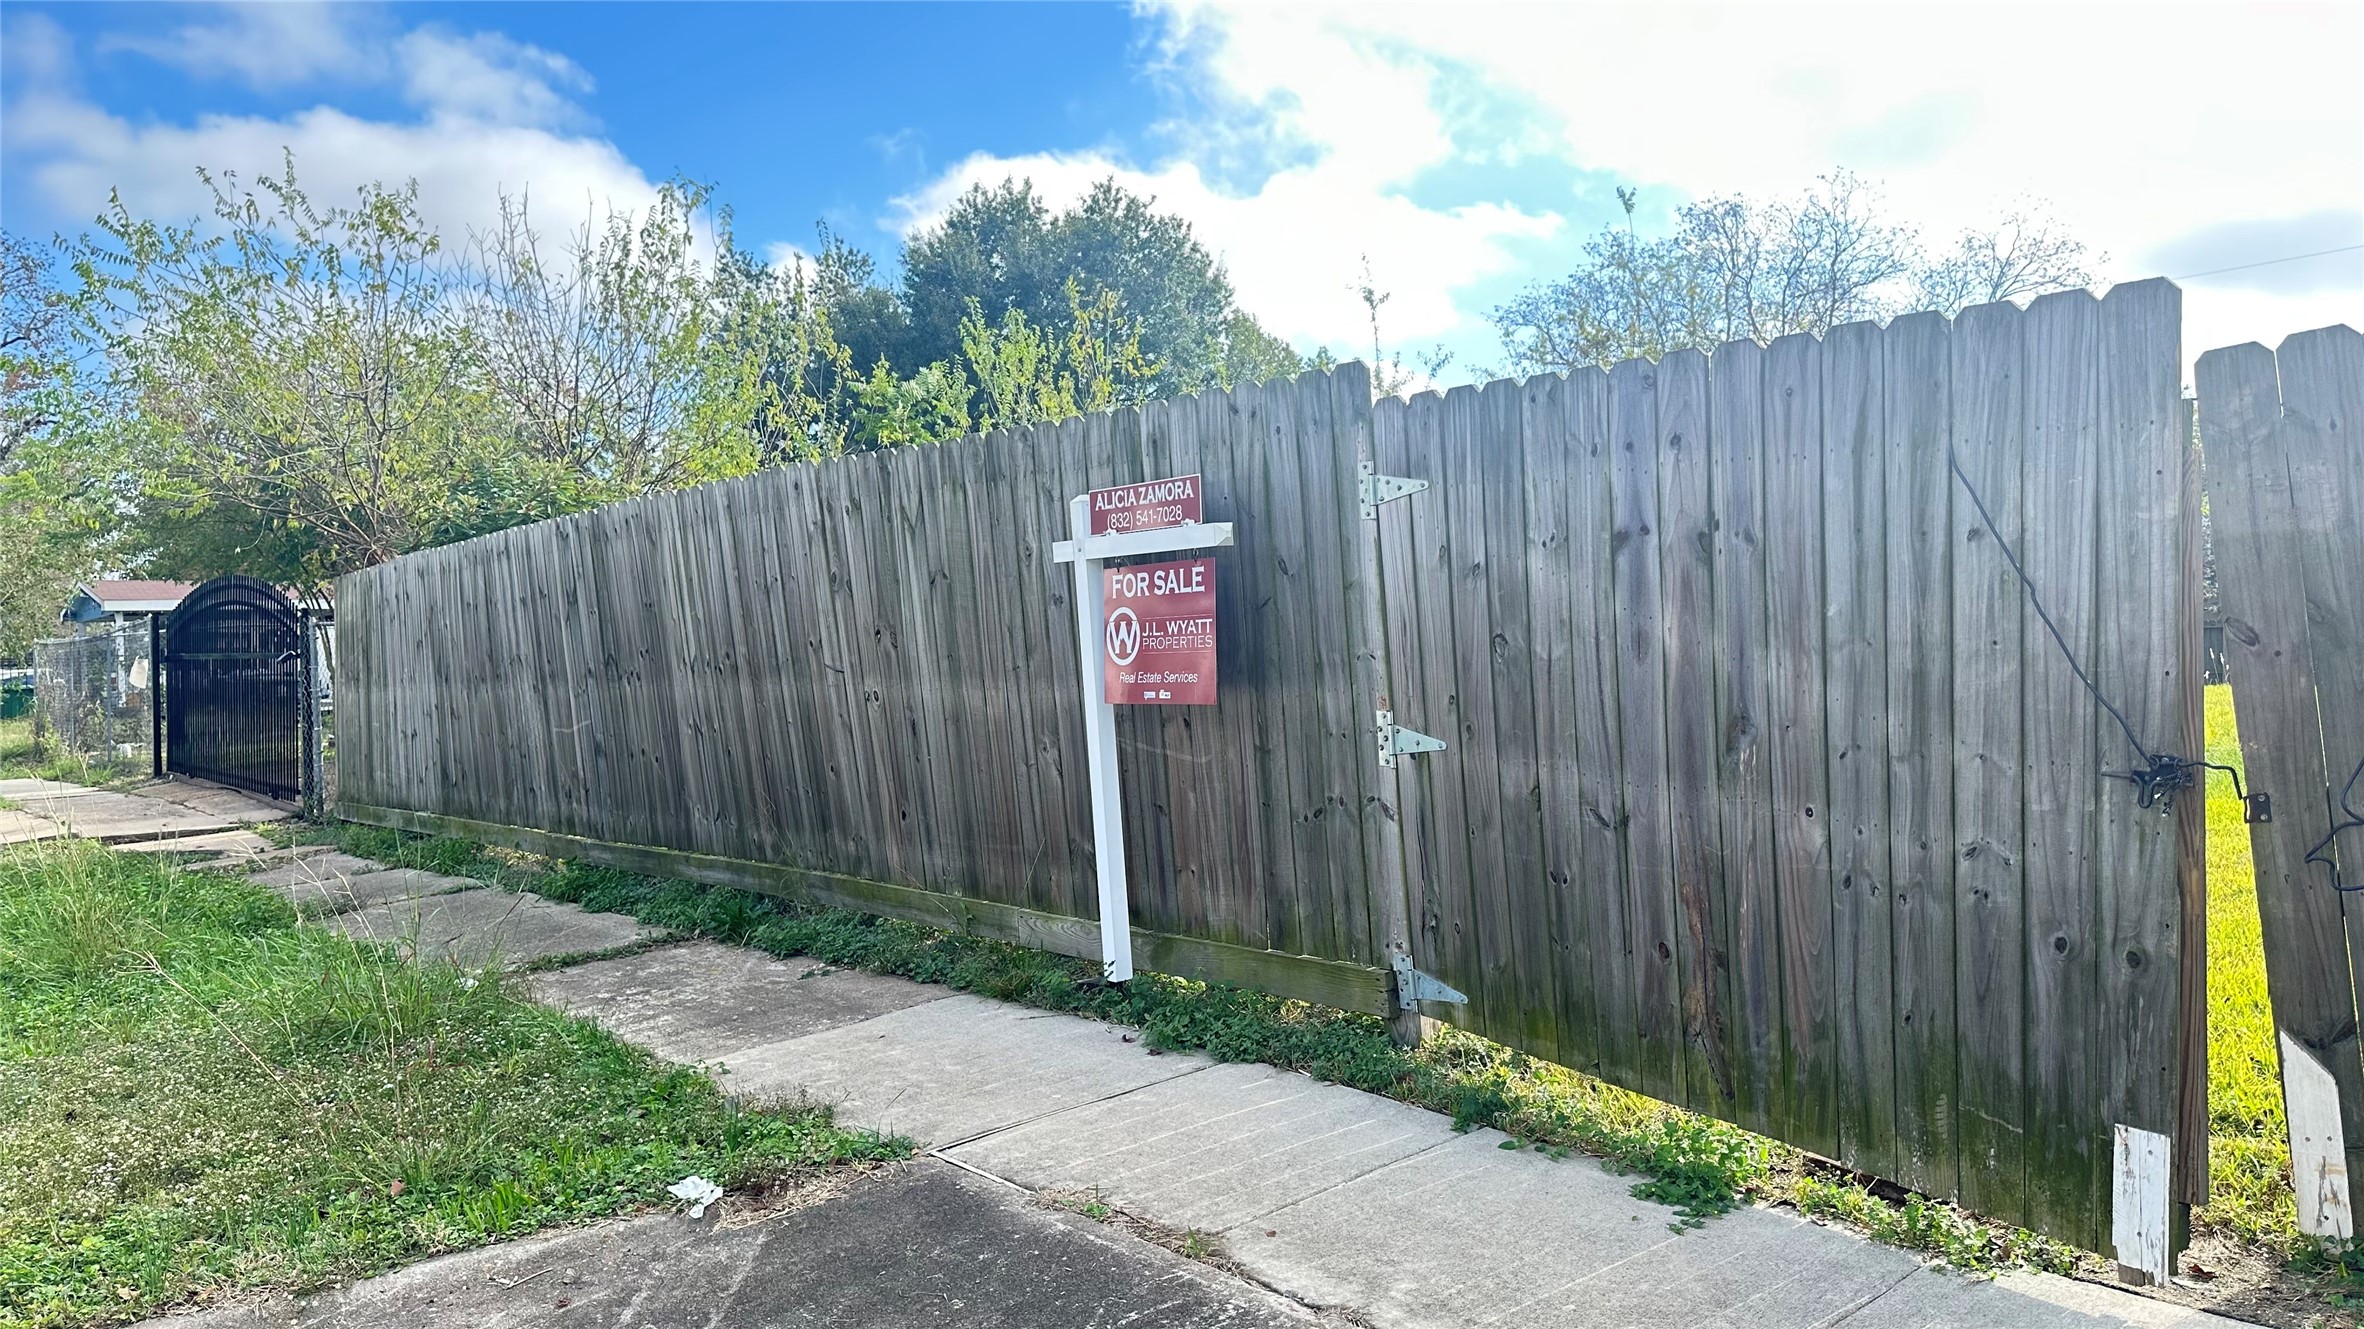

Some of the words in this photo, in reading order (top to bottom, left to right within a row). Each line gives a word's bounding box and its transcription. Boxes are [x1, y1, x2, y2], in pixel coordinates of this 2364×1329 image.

[1095, 489, 1137, 511] ALICIA
[1138, 480, 1194, 505] ZAMORA
[1107, 511, 1133, 530] (832)
[1136, 505, 1183, 526] 541-7028
[1112, 572, 1150, 599] FOR
[1153, 565, 1205, 596] SALE
[1142, 622, 1164, 637] J.L.
[1166, 619, 1213, 635] WYATT
[1142, 635, 1213, 650] PROPERTIES
[1119, 672, 1136, 684] Real
[1137, 671, 1162, 684] Estate
[1163, 671, 1198, 684] Services
